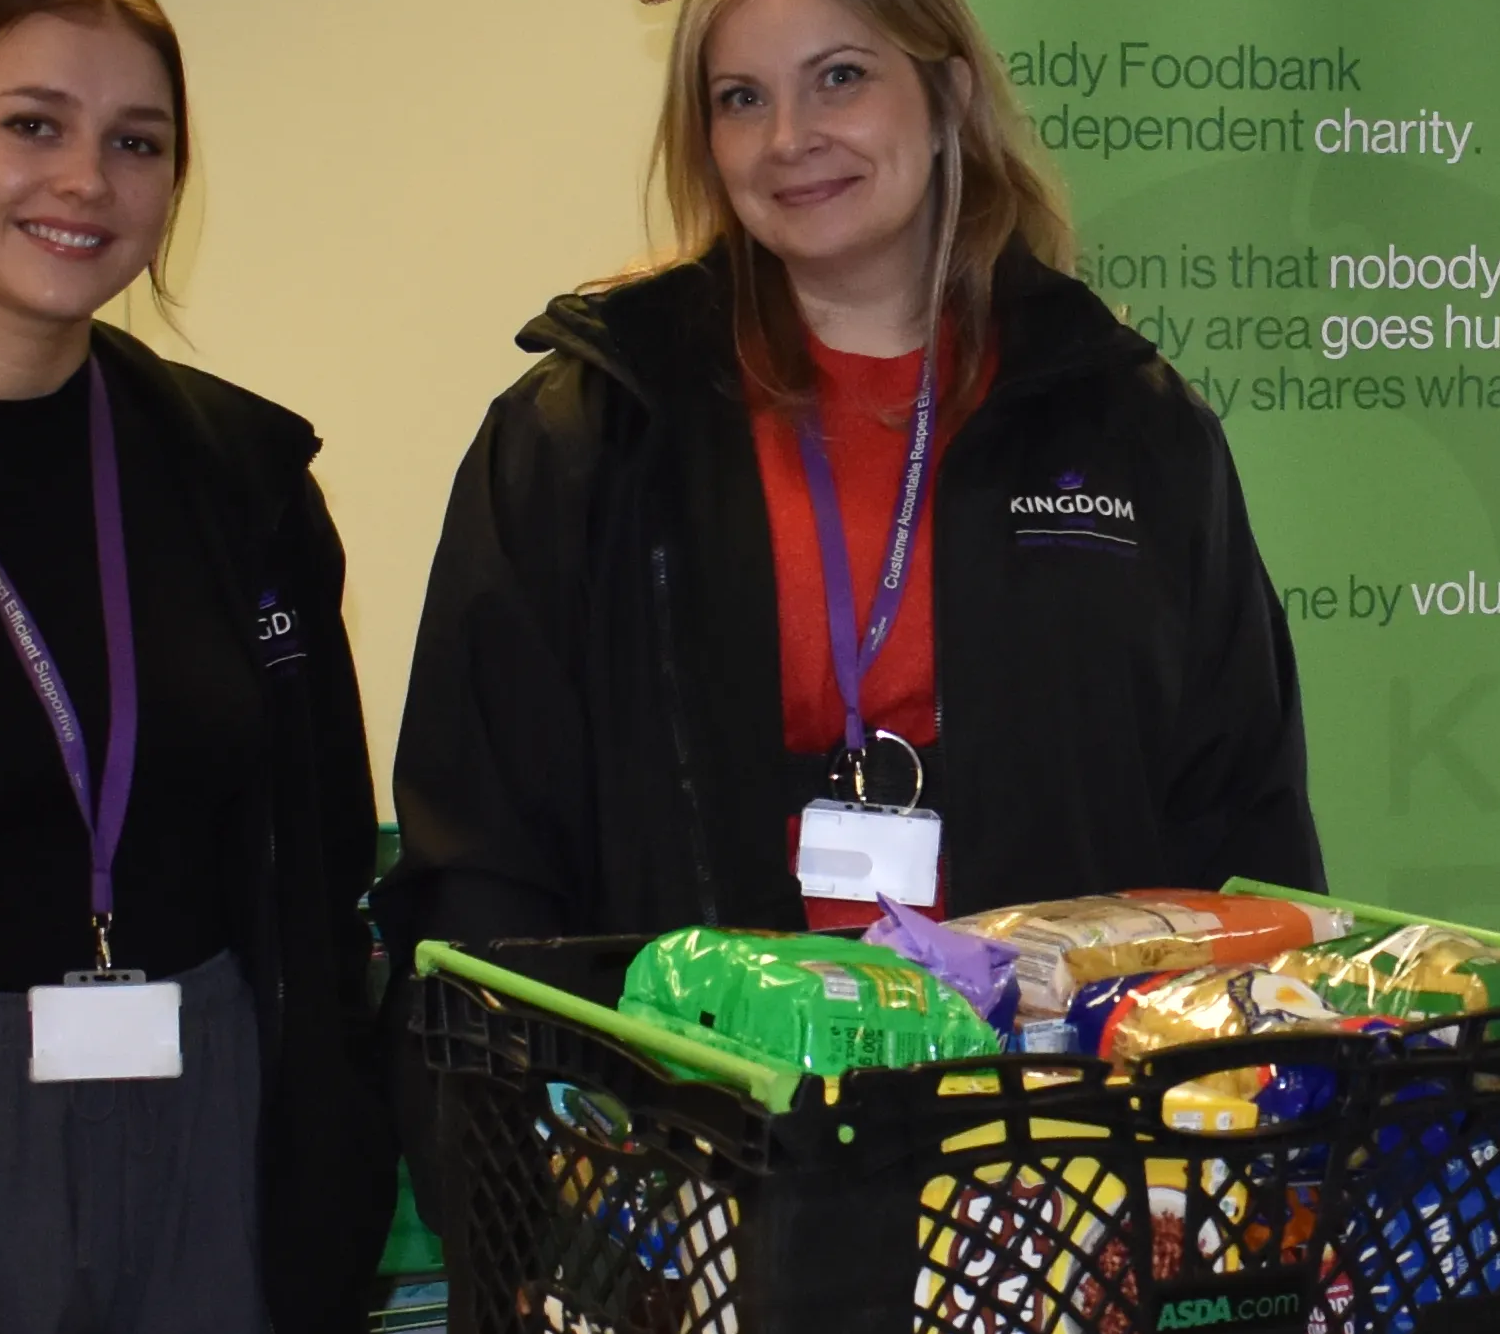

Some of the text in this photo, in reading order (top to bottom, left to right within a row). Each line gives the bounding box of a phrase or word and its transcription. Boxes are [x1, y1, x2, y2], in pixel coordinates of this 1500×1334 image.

[1008, 40, 1362, 97] aldy Foodbank
[1313, 108, 1482, 164] charity.
[1075, 243, 1167, 290] sion
[1180, 243, 1217, 290] is
[1227, 244, 1319, 290] that
[1204, 316, 1312, 353] area
[1321, 313, 1434, 360] goes
[1249, 367, 1406, 411] shares
[883, 524, 909, 590] Customer
[897, 461, 922, 526] Accountable
[910, 412, 929, 462] Respect
[1010, 494, 1136, 522] KINGDOM
[1282, 583, 1338, 621] ne
[1349, 574, 1403, 627] by
[3, 599, 42, 661] Efficient
[33, 658, 75, 743] Supportive
[1156, 1292, 1300, 1333] ASDA.com
